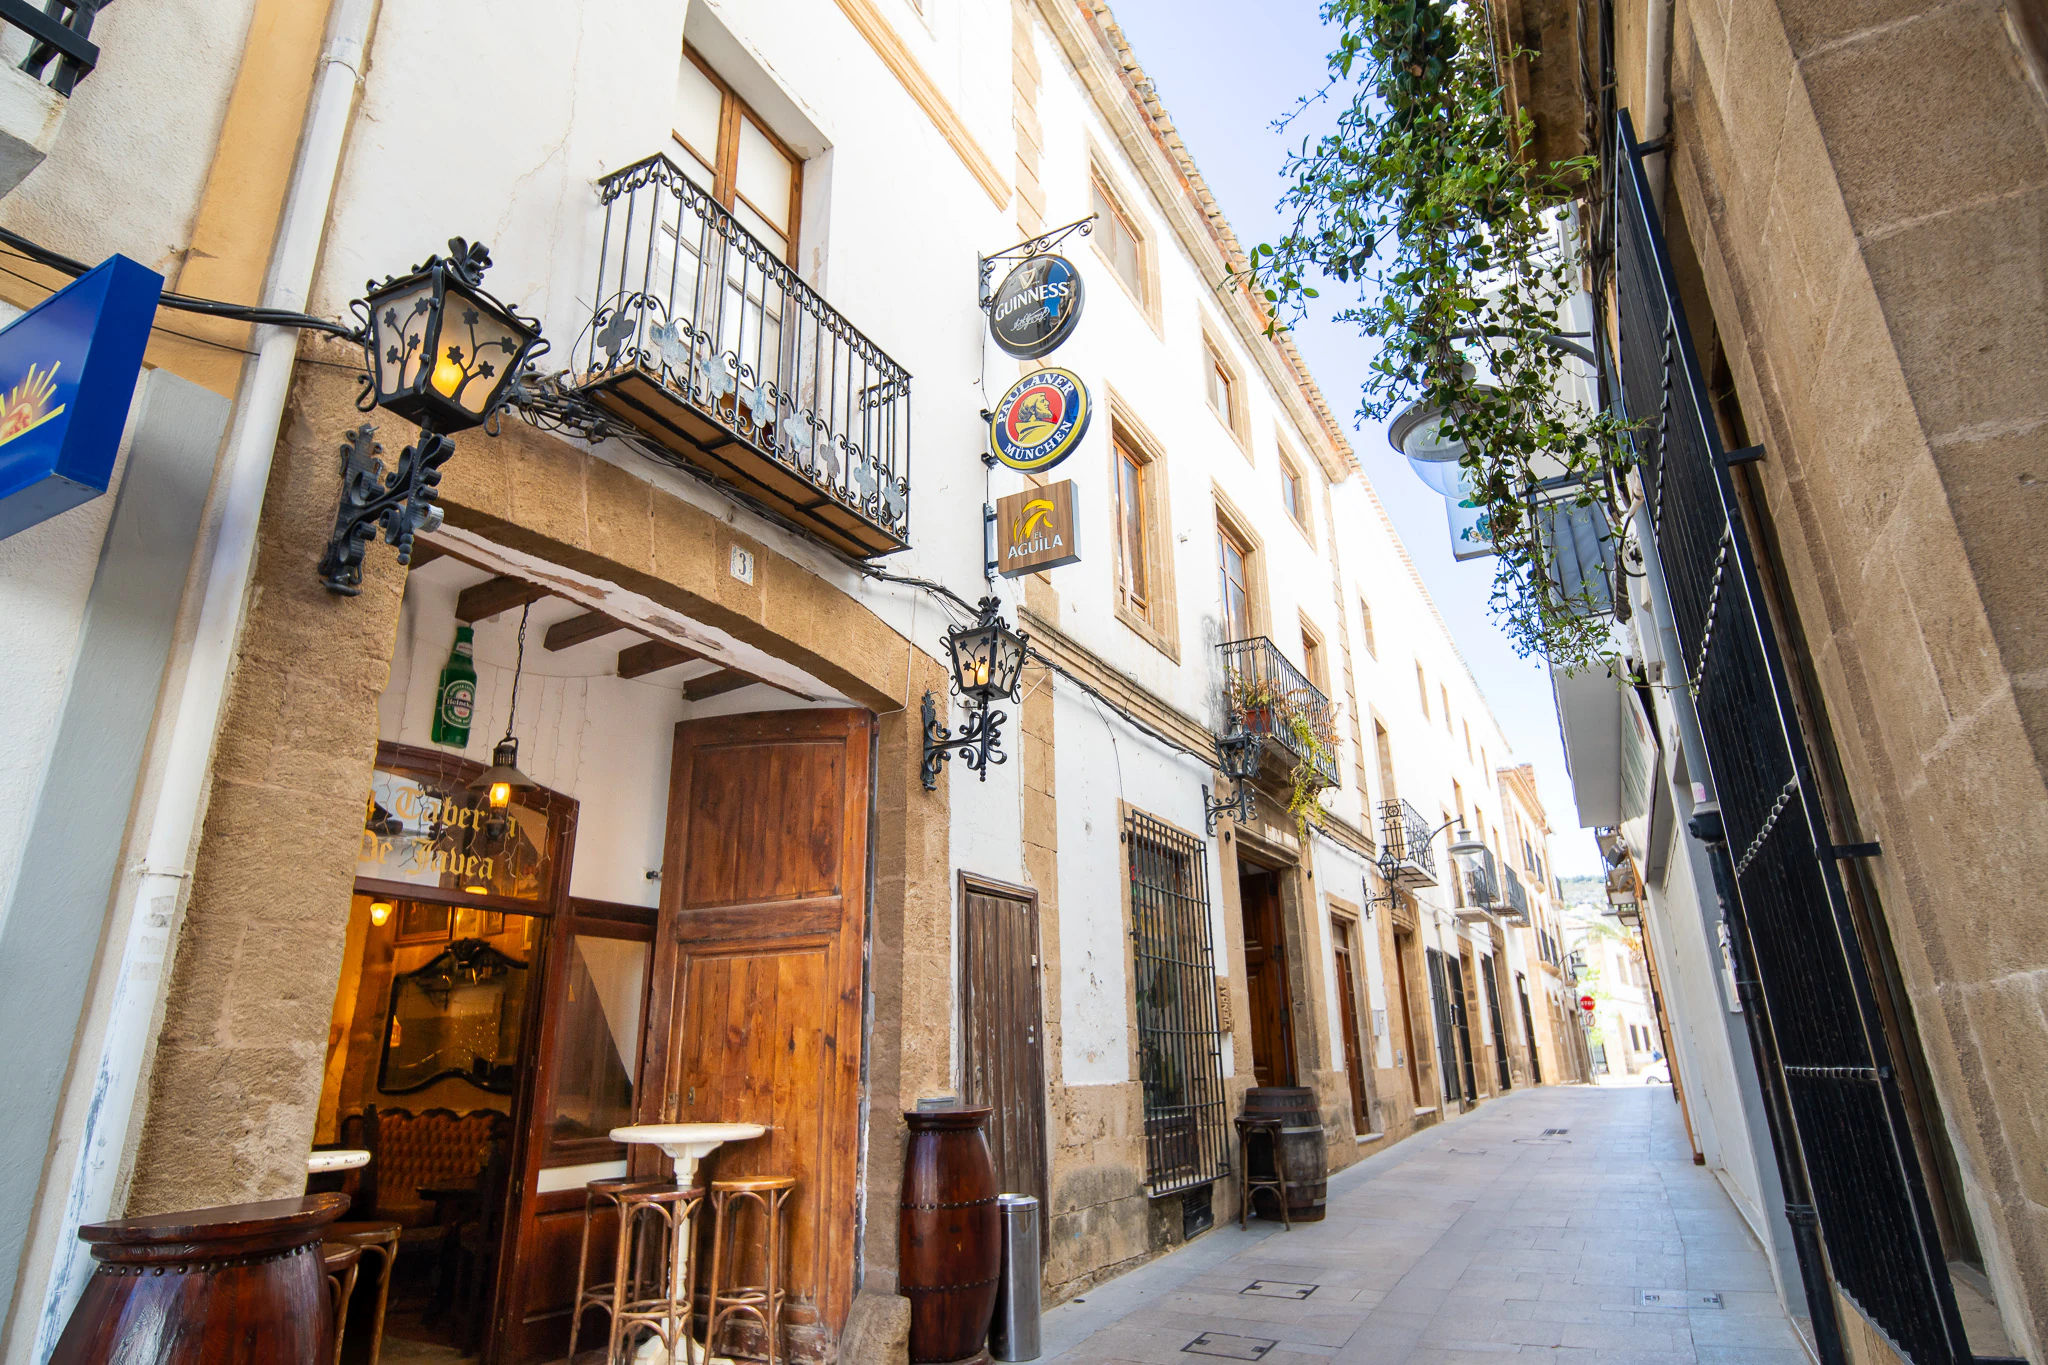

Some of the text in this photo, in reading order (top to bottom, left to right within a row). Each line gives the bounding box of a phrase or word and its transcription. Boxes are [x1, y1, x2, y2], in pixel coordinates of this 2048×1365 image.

[995, 281, 1069, 321] GUINNESS
[997, 373, 1075, 424] PAULANER
[1004, 420, 1072, 460] MÜNCHEN
[1008, 534, 1063, 560] AGUILA
[1034, 531, 1043, 539] EL
[739, 553, 747, 576] 3
[358, 829, 493, 881] De Javea
